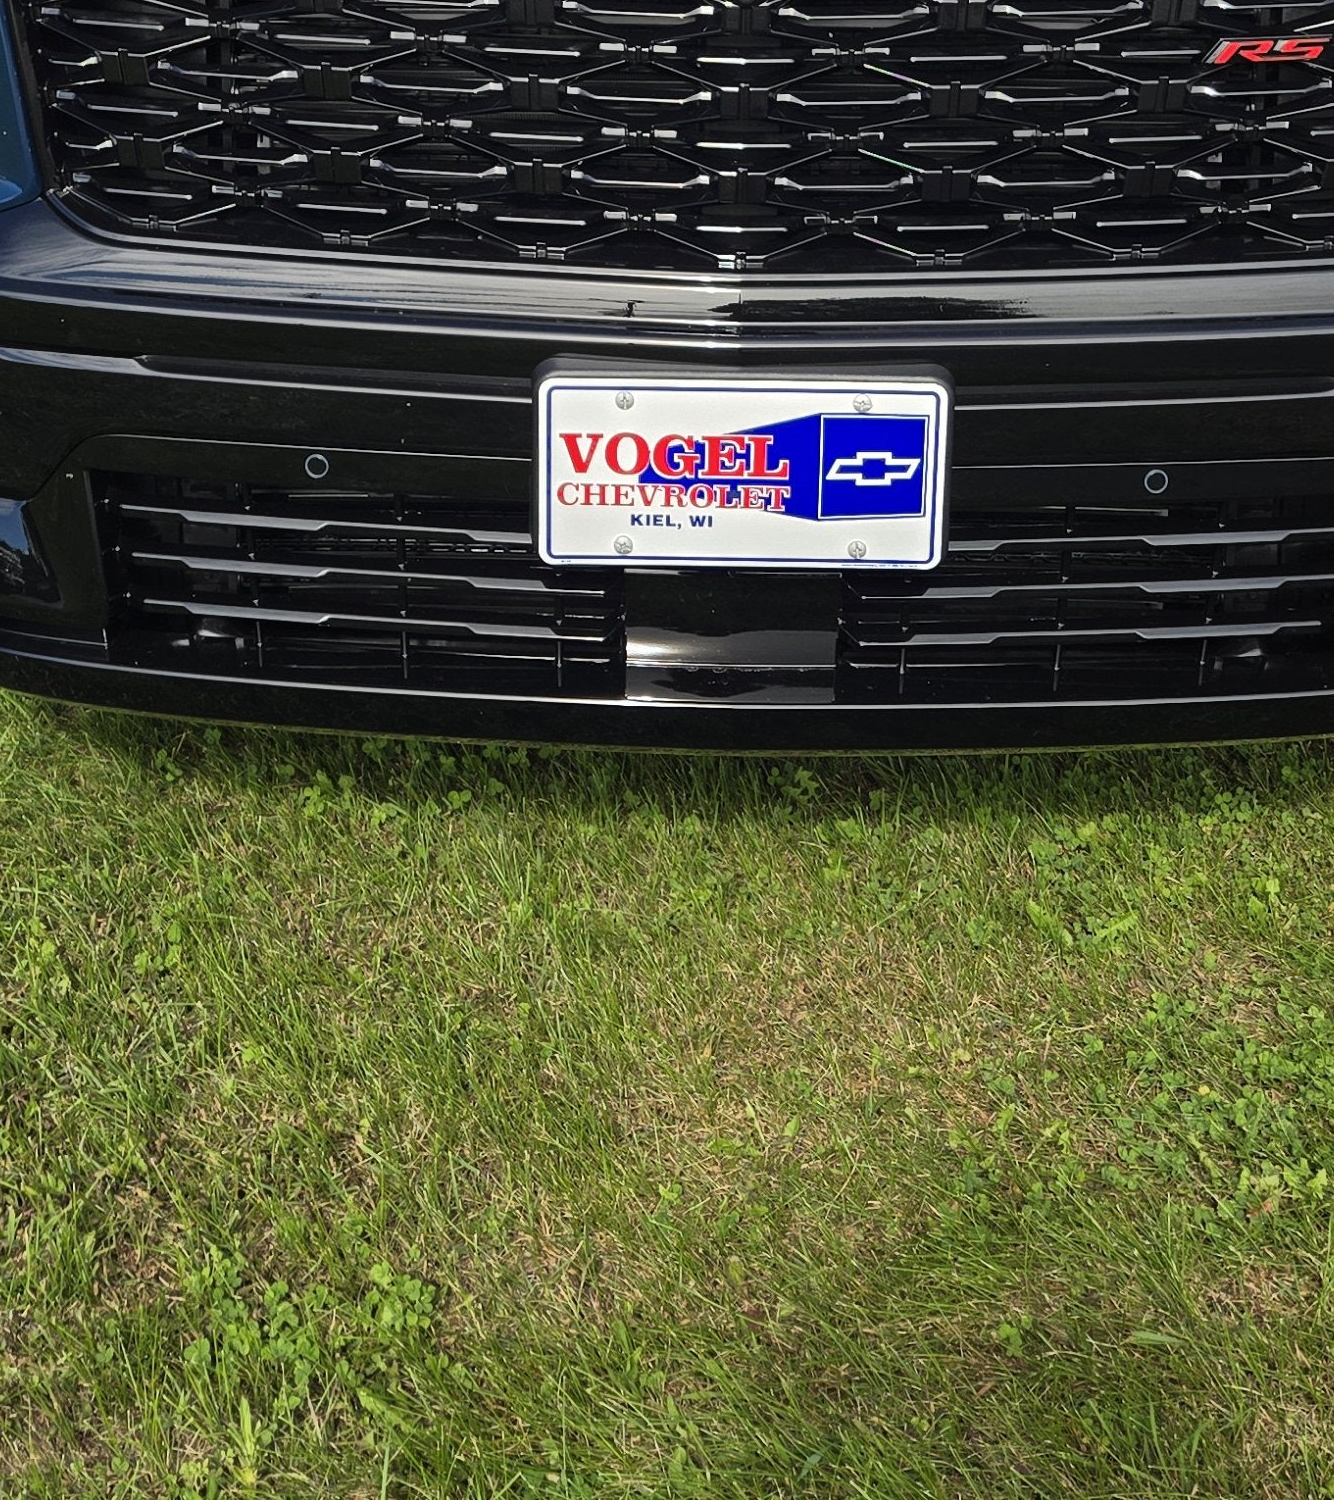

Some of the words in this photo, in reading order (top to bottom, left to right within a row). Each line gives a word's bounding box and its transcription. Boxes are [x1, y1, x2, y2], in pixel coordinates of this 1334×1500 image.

[1205, 36, 1330, 64] RS
[559, 432, 790, 478] VOGEL
[556, 482, 791, 512] CHEVROLET
[630, 513, 682, 530] KIEL,
[689, 515, 713, 528] WI
